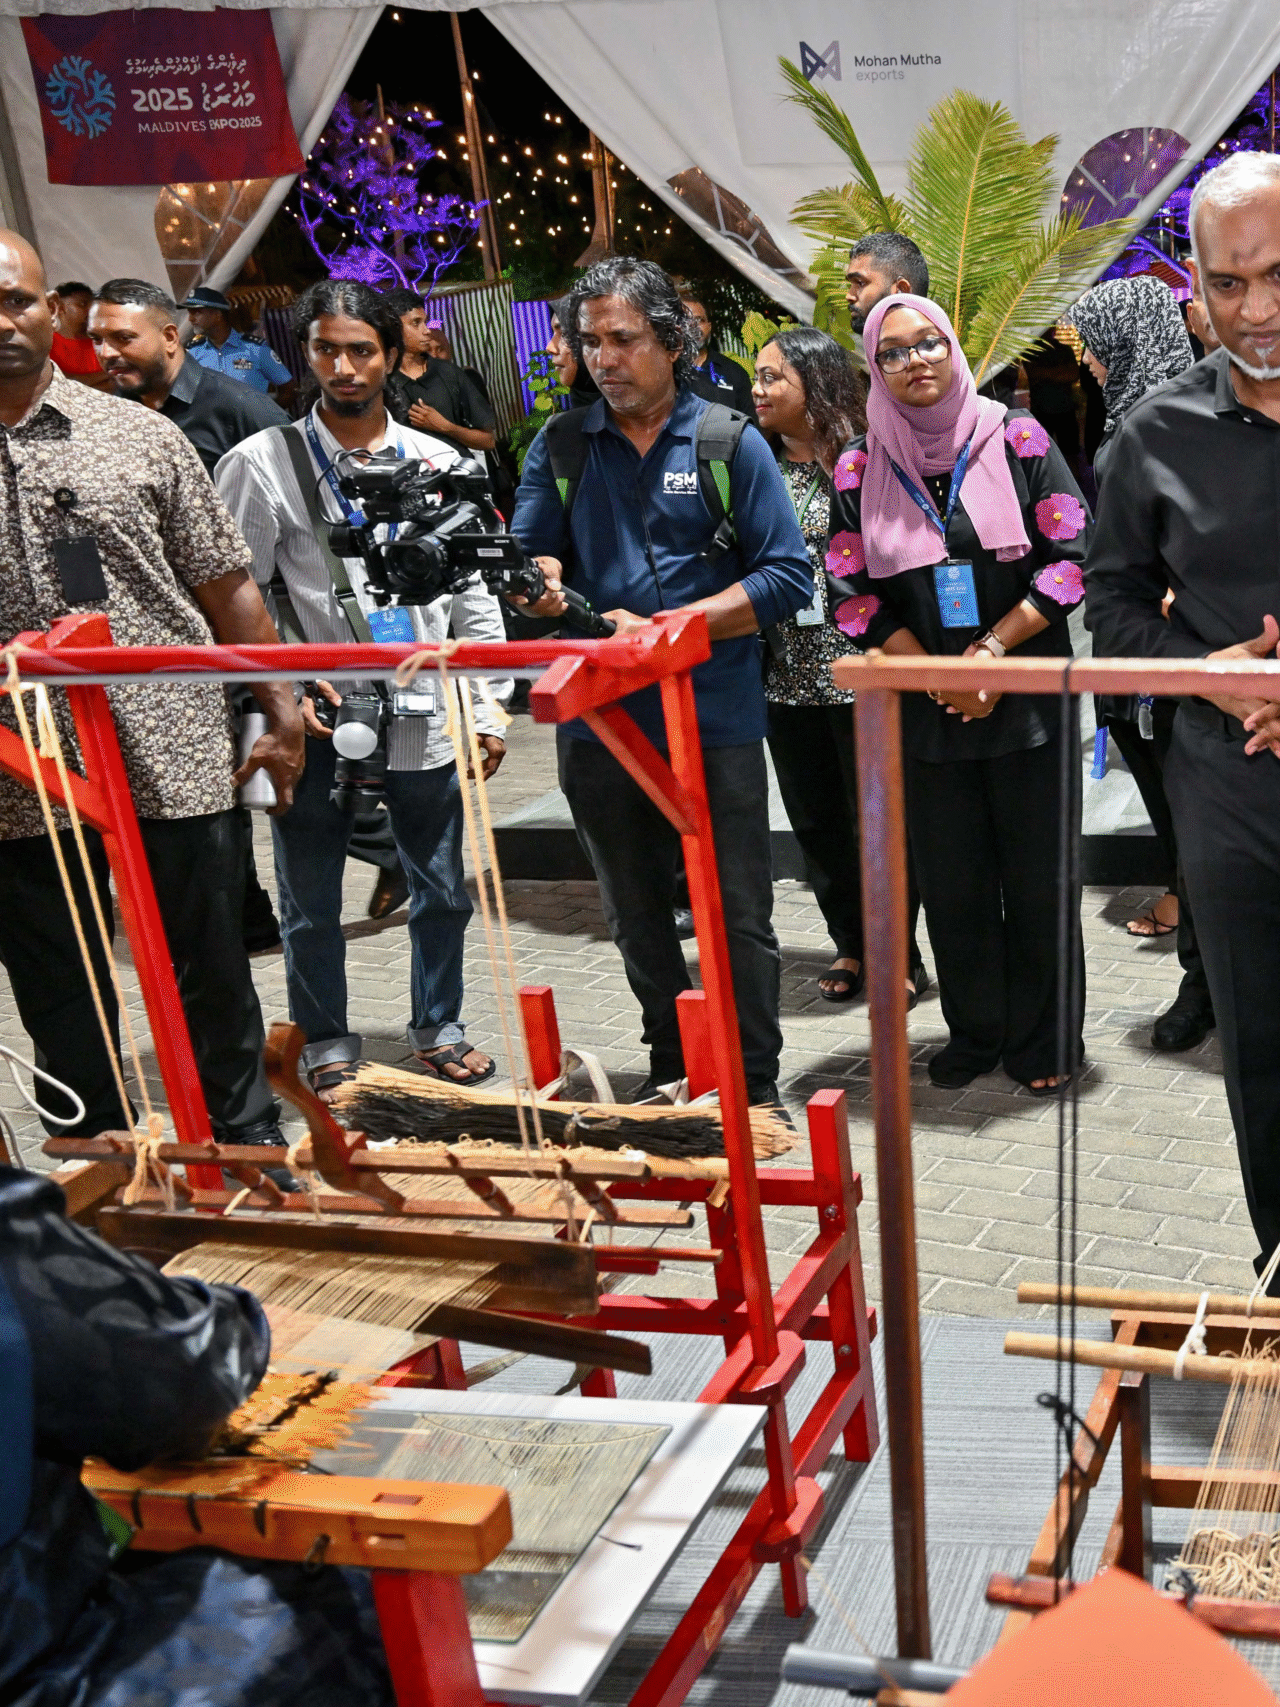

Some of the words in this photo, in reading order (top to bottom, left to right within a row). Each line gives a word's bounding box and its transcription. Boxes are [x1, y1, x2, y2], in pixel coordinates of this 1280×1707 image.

[854, 55, 898, 67] Mohan
[900, 53, 941, 66] Mutha
[856, 69, 905, 83] exports
[131, 87, 193, 112] 2025
[138, 121, 207, 133] MALDIVES
[664, 472, 697, 486] PSM
